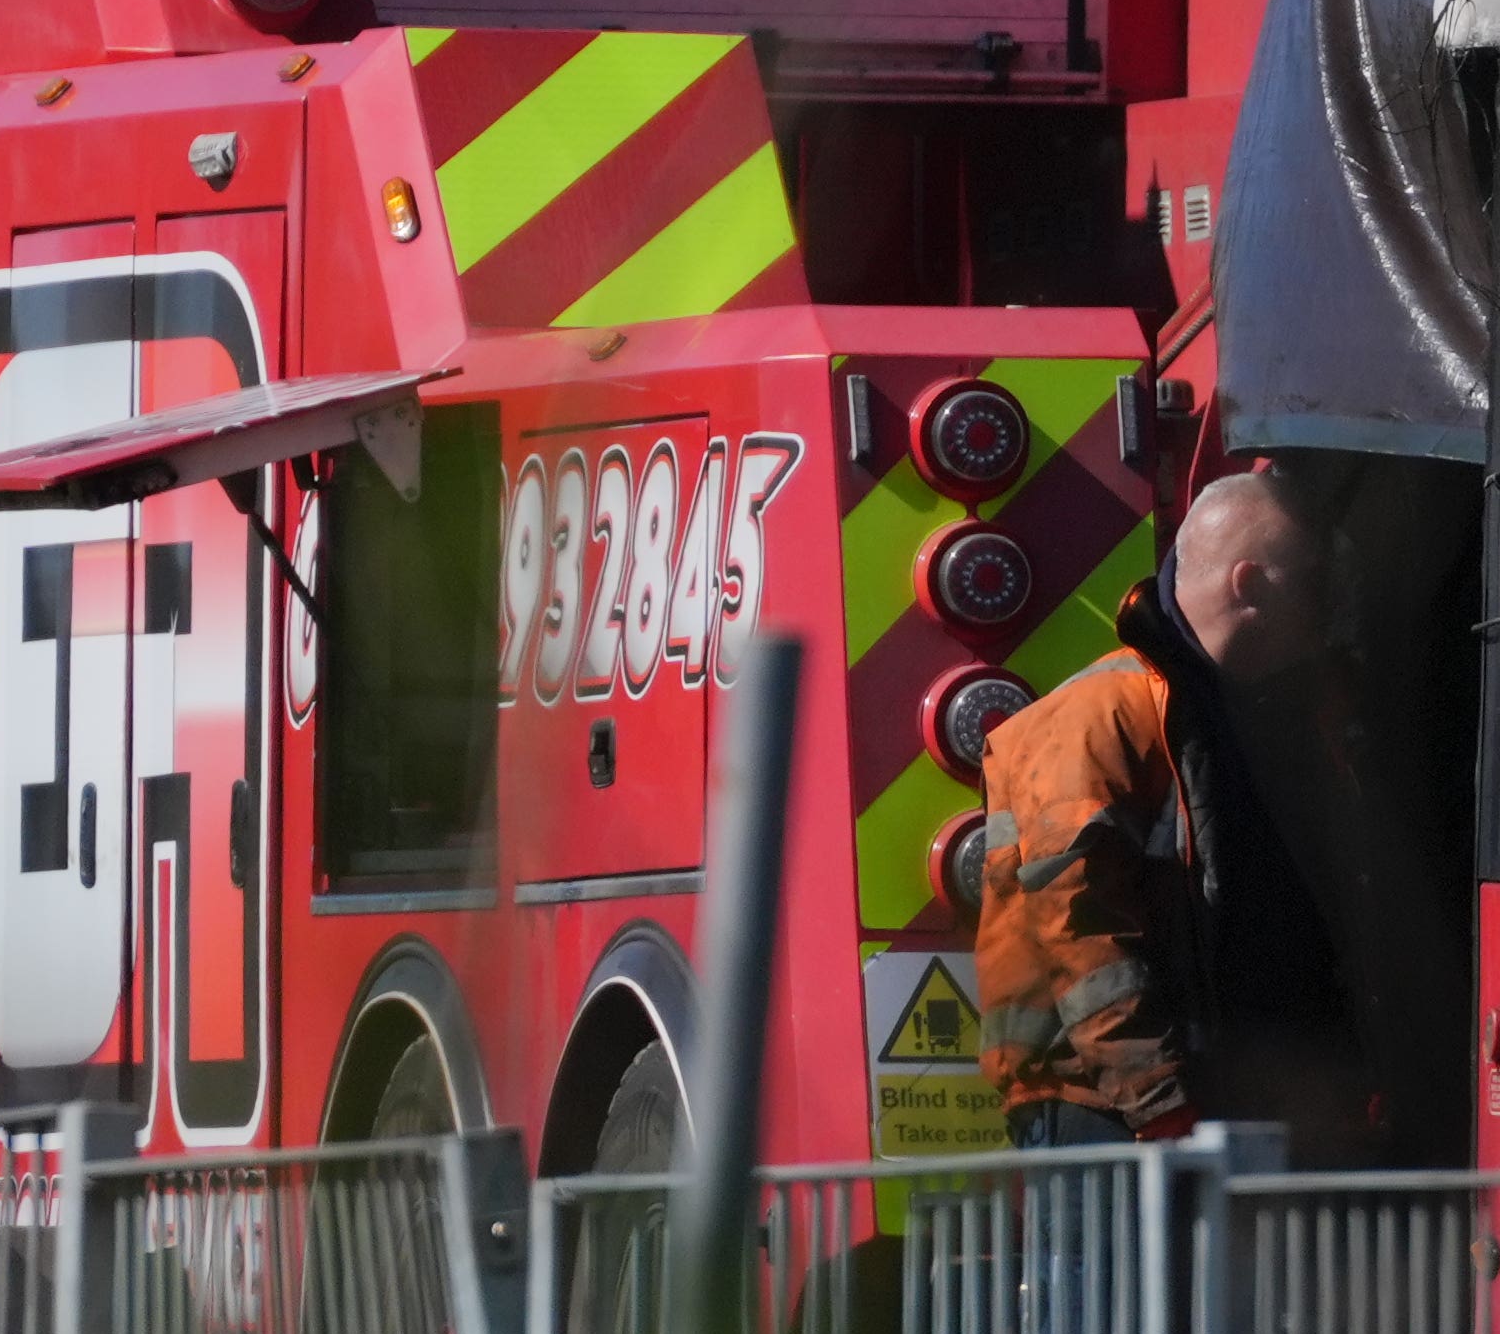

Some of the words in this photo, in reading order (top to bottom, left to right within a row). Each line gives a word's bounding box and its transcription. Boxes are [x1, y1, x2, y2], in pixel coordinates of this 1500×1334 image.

[880, 1086, 947, 1109] Blind
[955, 1090, 1002, 1113] spo
[895, 1123, 948, 1143] Take
[954, 1127, 1005, 1144] care
